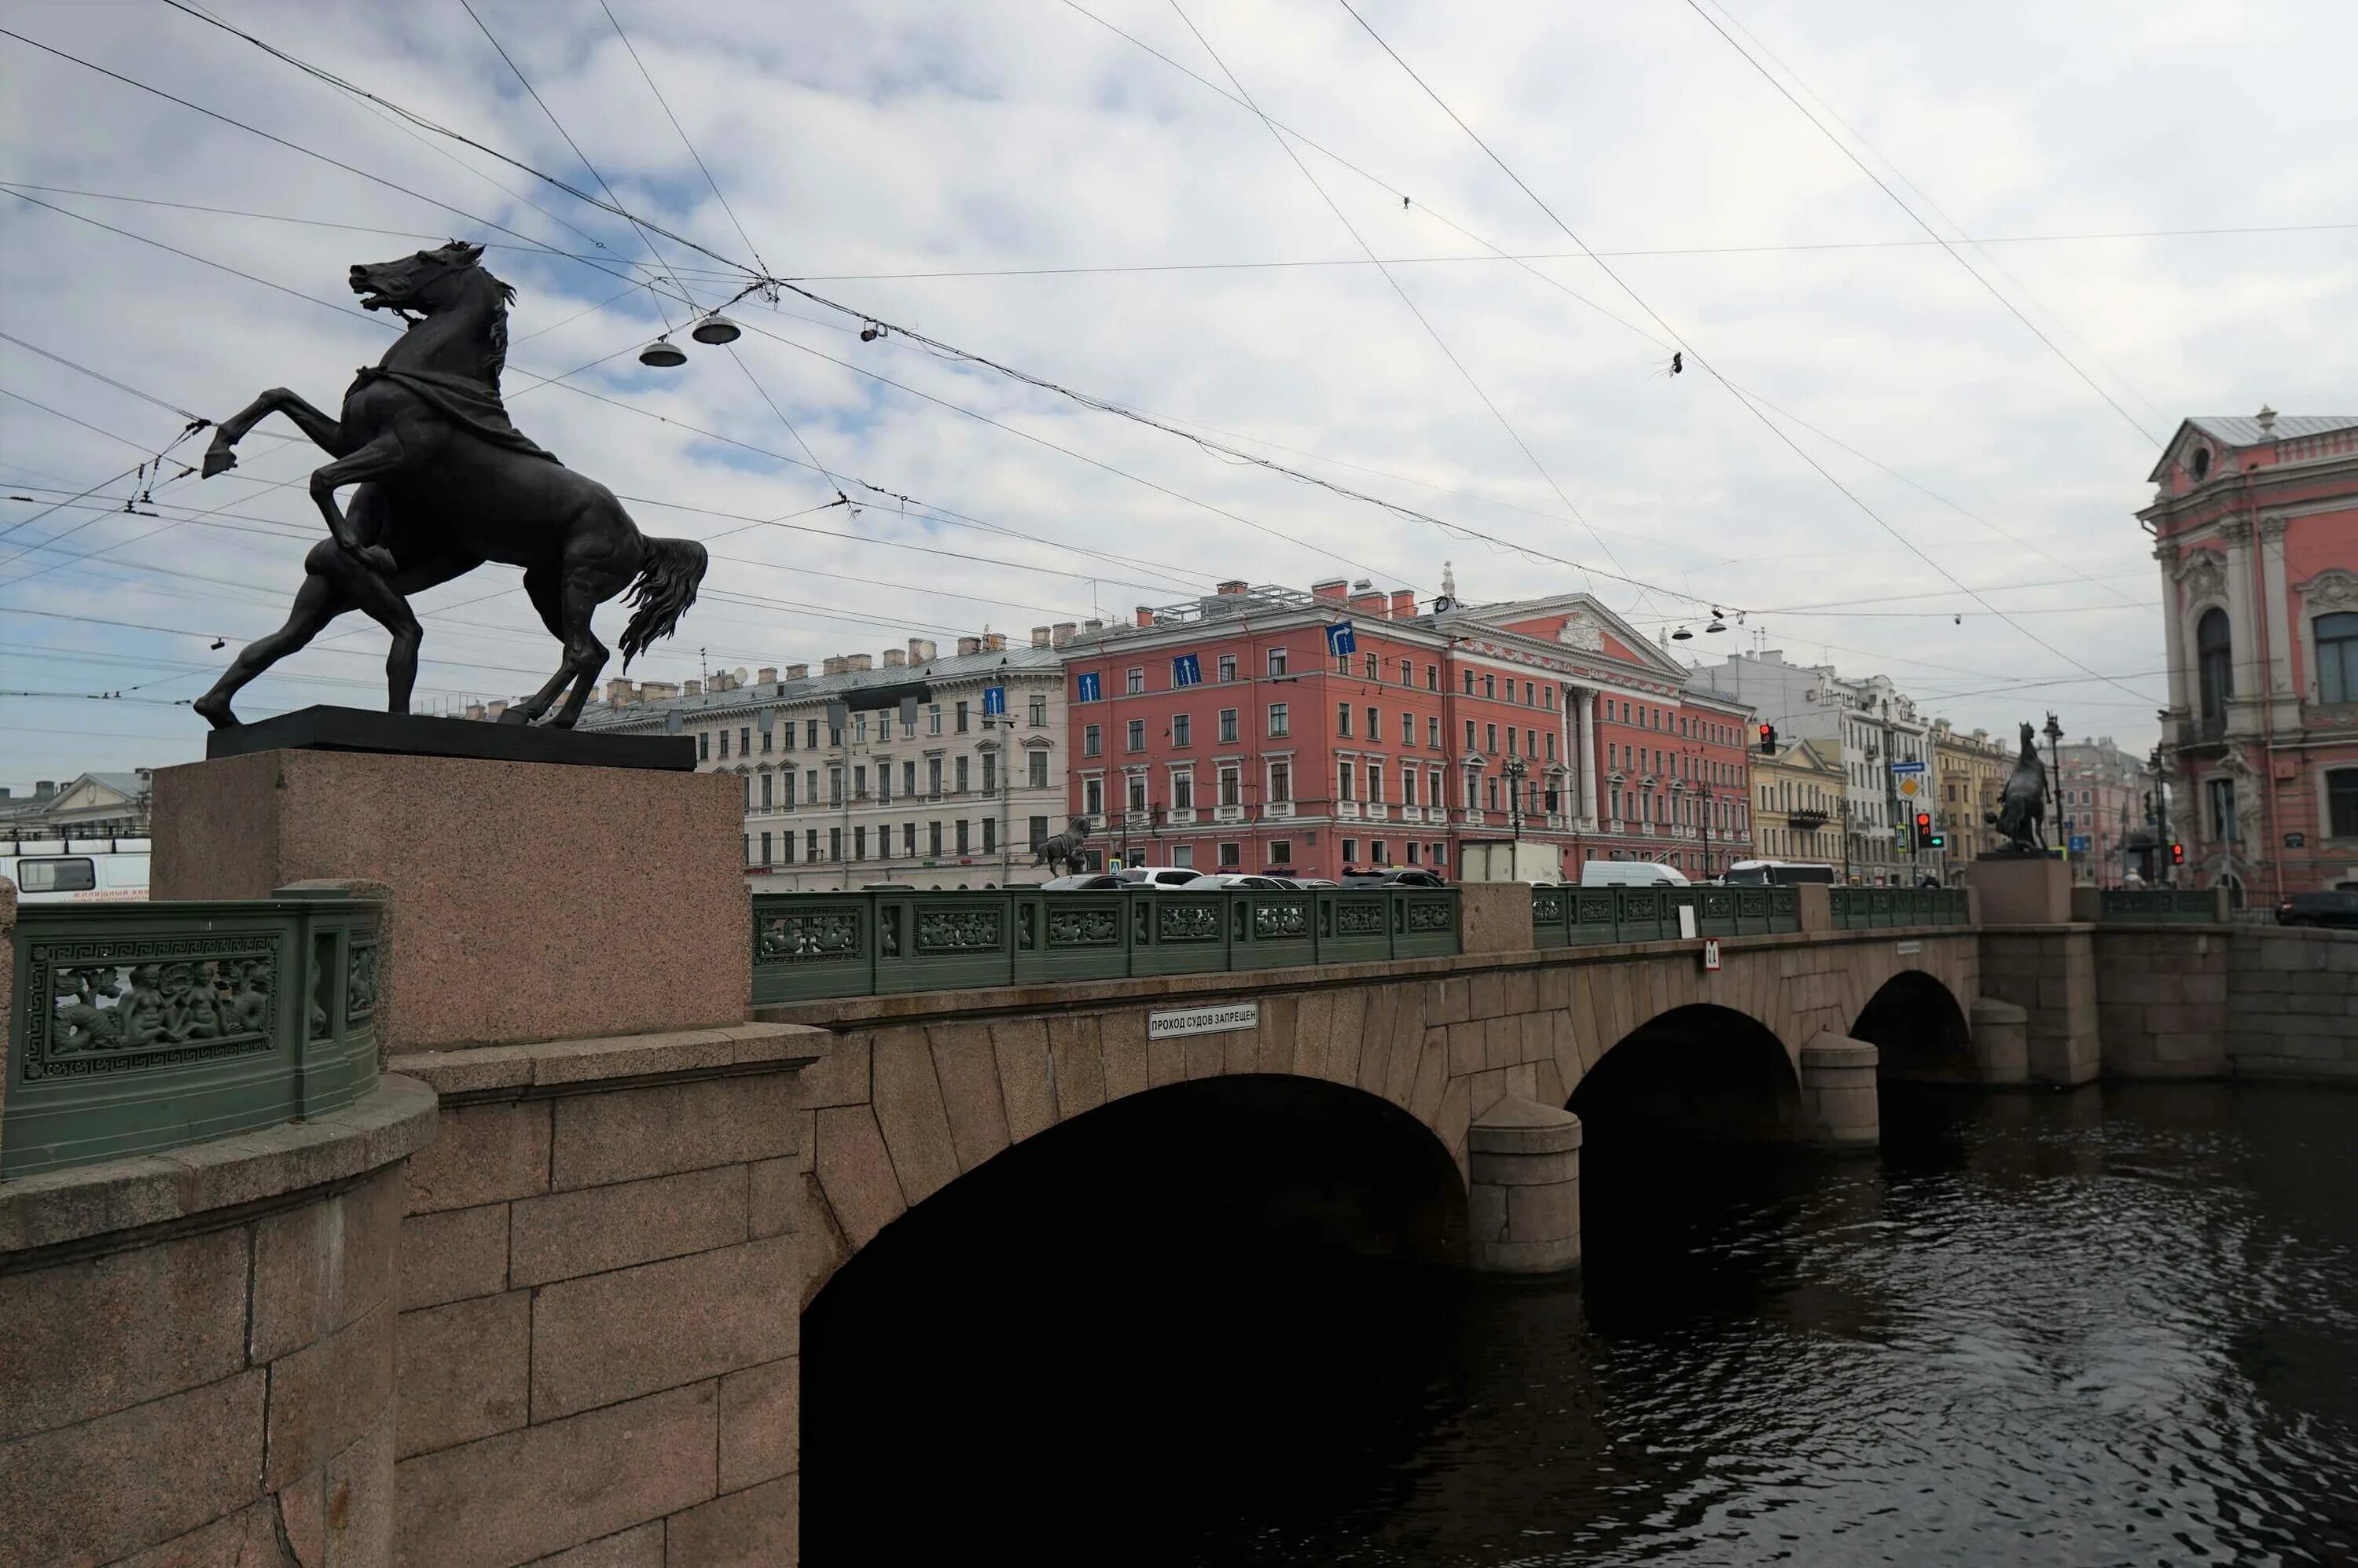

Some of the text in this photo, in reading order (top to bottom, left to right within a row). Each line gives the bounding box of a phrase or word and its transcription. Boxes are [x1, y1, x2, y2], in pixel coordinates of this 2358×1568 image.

[1151, 1011, 1255, 1031] ПРОХОД СУДОВ ЗАПРЕЩЕН
